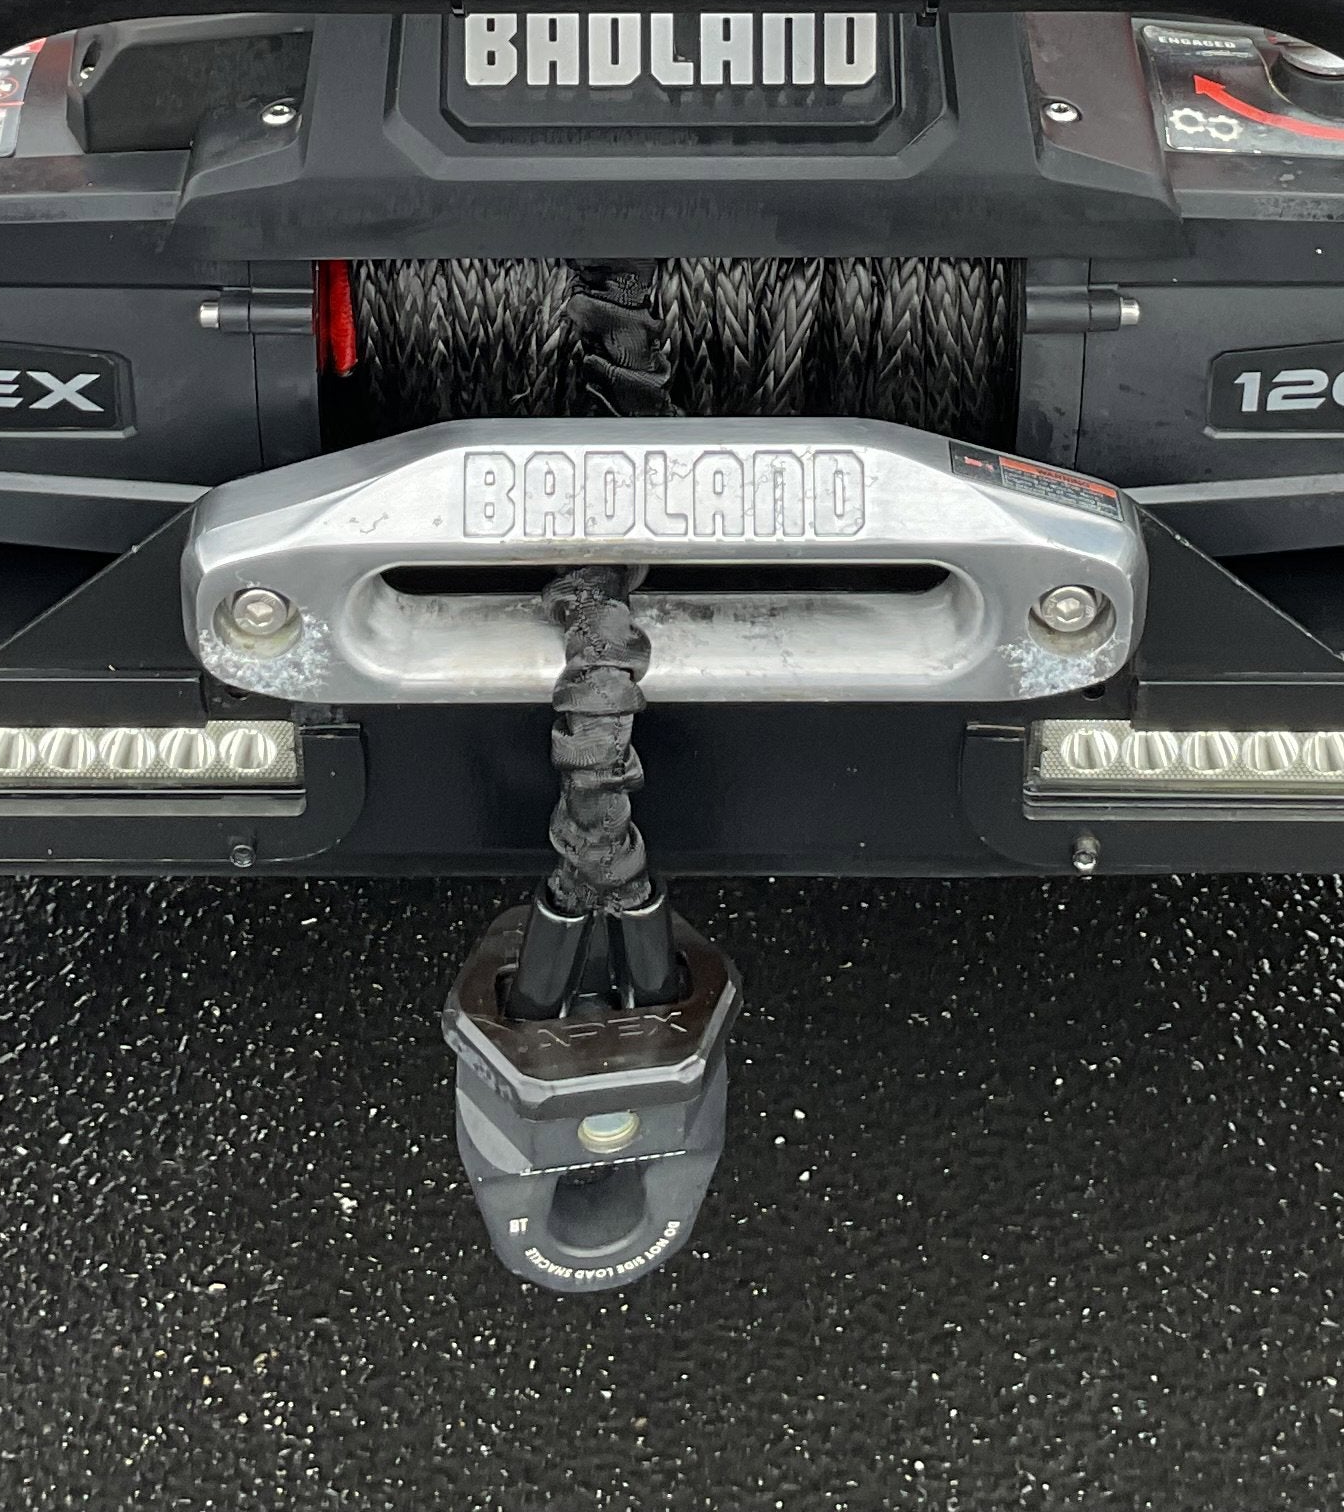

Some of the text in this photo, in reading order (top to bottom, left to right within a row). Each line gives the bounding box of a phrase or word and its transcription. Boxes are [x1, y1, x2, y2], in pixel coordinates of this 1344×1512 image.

[465, 12, 877, 86] BADLAND
[1158, 35, 1236, 49] ENGAGED
[463, 449, 866, 542] BADLAND
[524, 1220, 681, 1280] DO NOT SIDE LOAD SHACKLE
